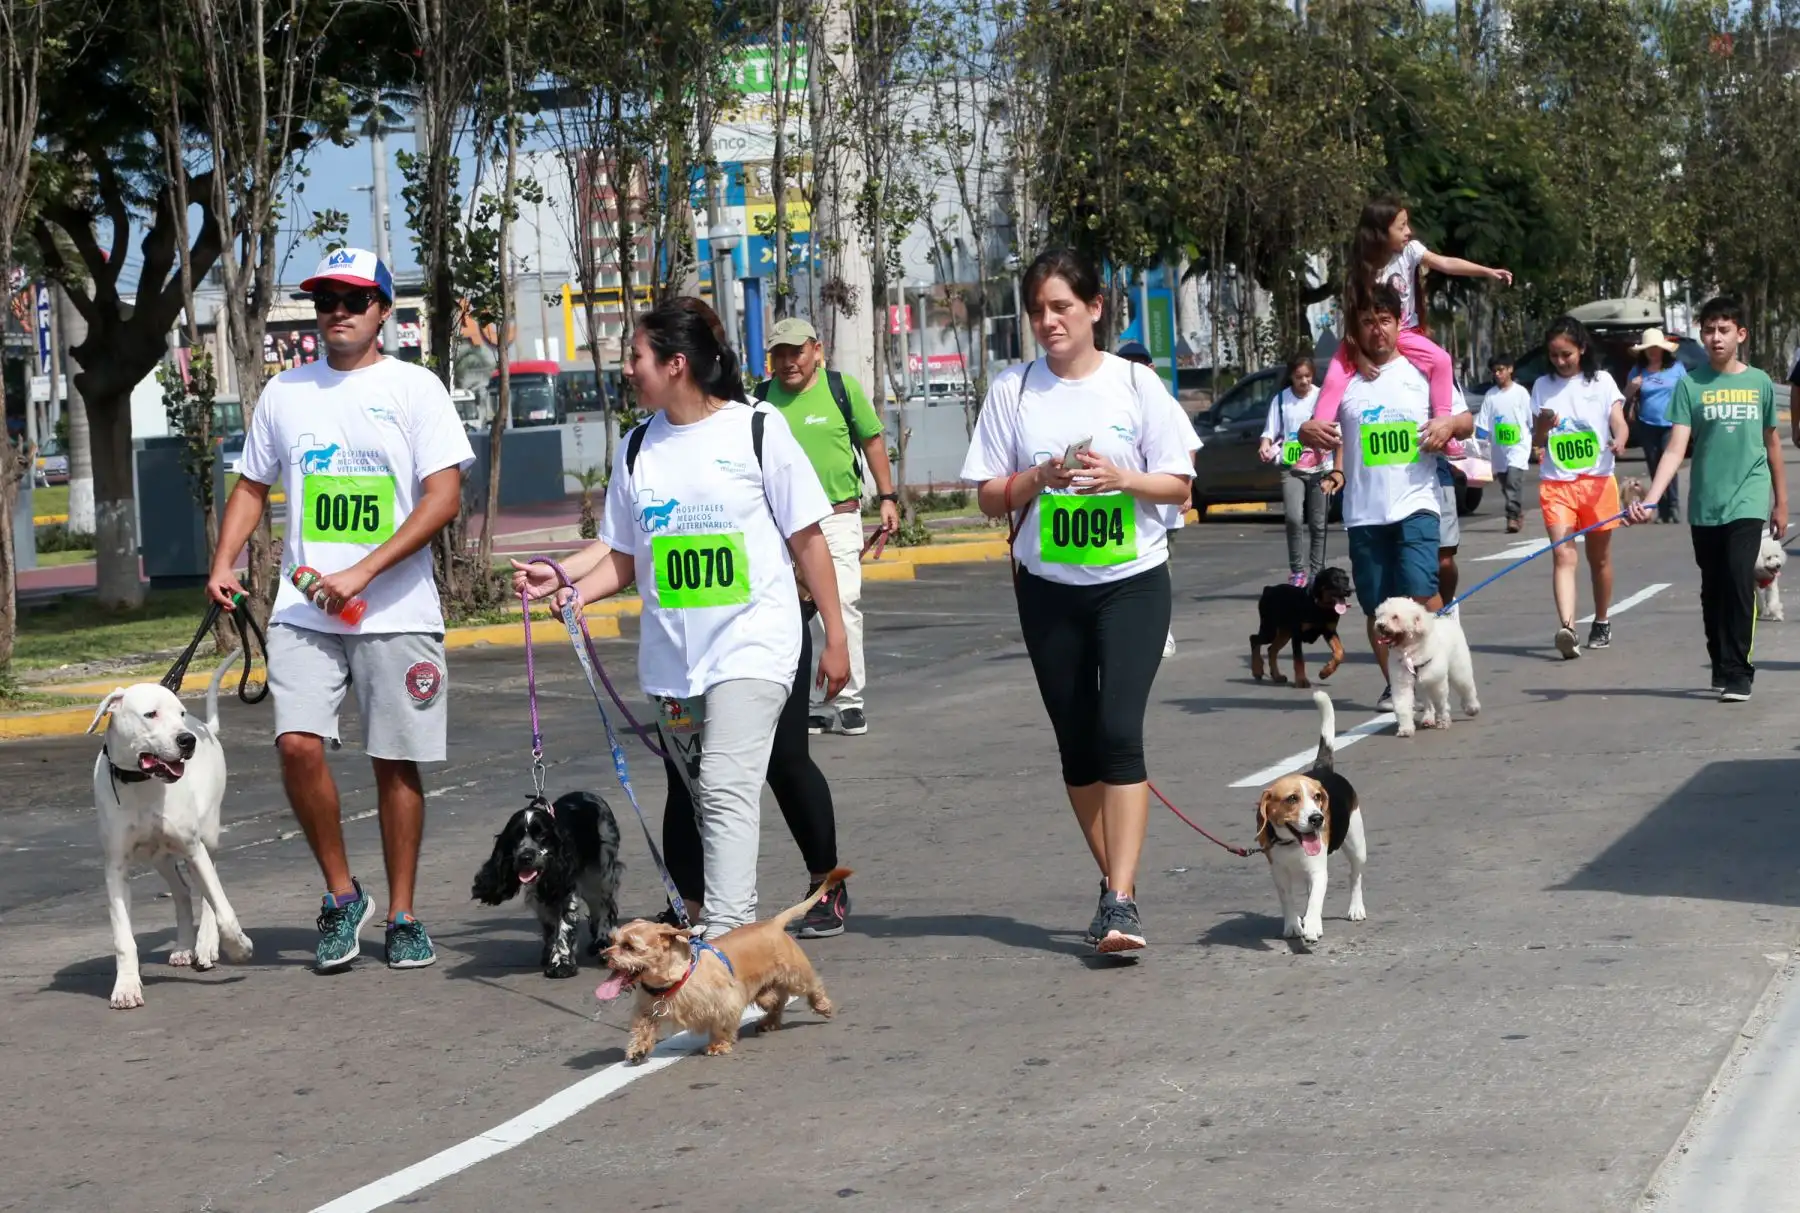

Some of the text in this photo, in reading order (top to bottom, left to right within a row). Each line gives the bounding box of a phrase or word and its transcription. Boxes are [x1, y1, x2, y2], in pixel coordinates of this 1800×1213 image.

[1702, 389, 1760, 405] GAME
[1703, 404, 1759, 420] OVER
[1369, 429, 1410, 456] 0100
[1556, 438, 1594, 462] 0066
[315, 493, 380, 532] 0075
[676, 504, 724, 514] HOSPITALES
[1052, 507, 1125, 548] 0094
[667, 546, 734, 590] 0070
